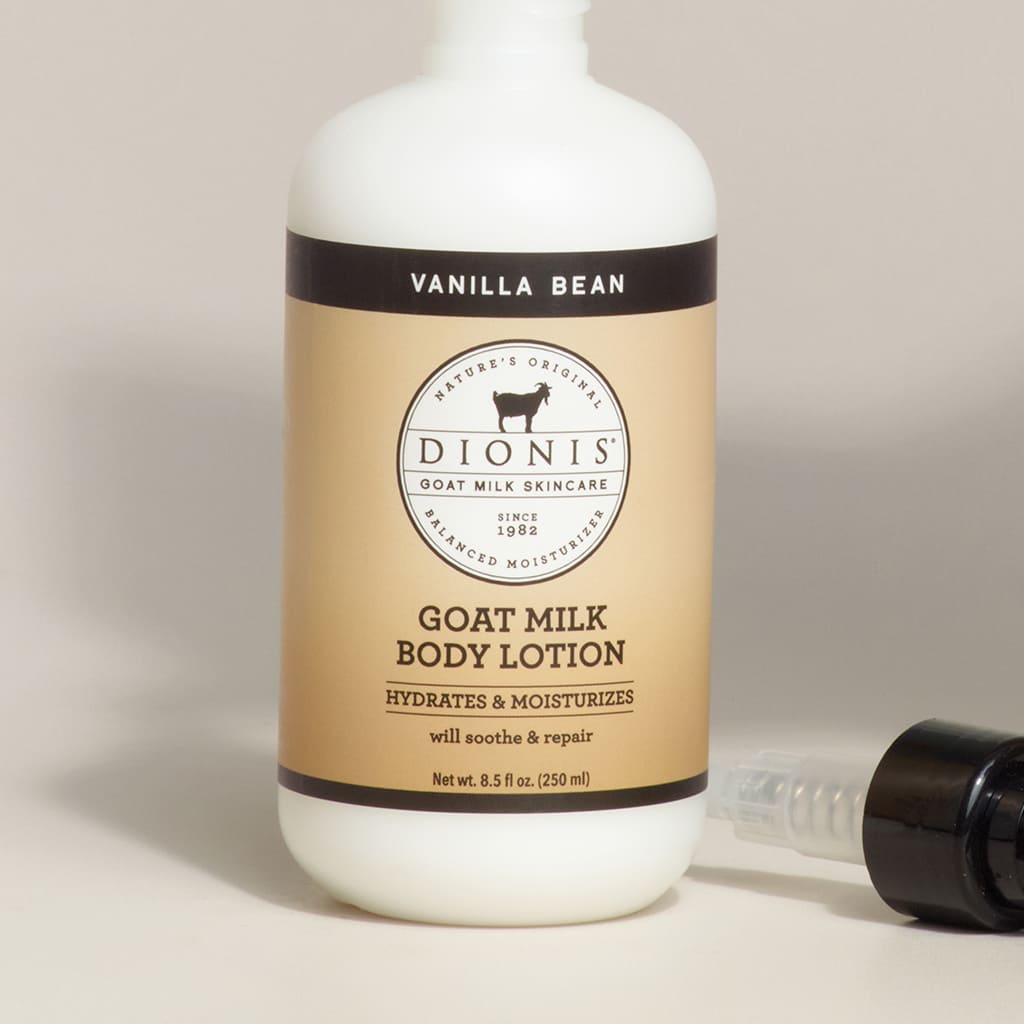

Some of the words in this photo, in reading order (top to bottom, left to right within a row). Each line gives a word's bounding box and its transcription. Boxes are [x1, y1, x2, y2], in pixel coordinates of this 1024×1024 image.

[410, 273, 532, 296] VANILLA
[552, 274, 624, 296] BEAN
[435, 357, 517, 402] NATURE'S
[528, 357, 602, 409] ORIGINAL
[420, 478, 465, 491] GOAT
[474, 479, 514, 492] MILK
[524, 479, 608, 492] SKINCARE
[497, 513, 538, 522] SINCE
[425, 508, 497, 566] BALANCED
[507, 509, 604, 569] MOISTURIZER
[497, 525, 538, 536] 1982
[418, 605, 516, 633] GOAT
[524, 605, 607, 633] MILK
[396, 640, 491, 668] BODY
[499, 640, 626, 669] LOTION
[385, 689, 487, 709] HYDRATES
[492, 695, 506, 709] &
[510, 689, 635, 709] MOISTURIZES
[429, 728, 461, 744] will
[465, 729, 523, 745] soothe
[527, 730, 540, 745] &
[543, 729, 594, 747] repair
[433, 772, 454, 787] Net
[457, 773, 477, 788] wt.
[480, 773, 501, 788] 8.5
[504, 772, 513, 788] fl
[517, 776, 535, 788] oz.
[537, 772, 567, 789] (250
[570, 771, 590, 788] ml)
